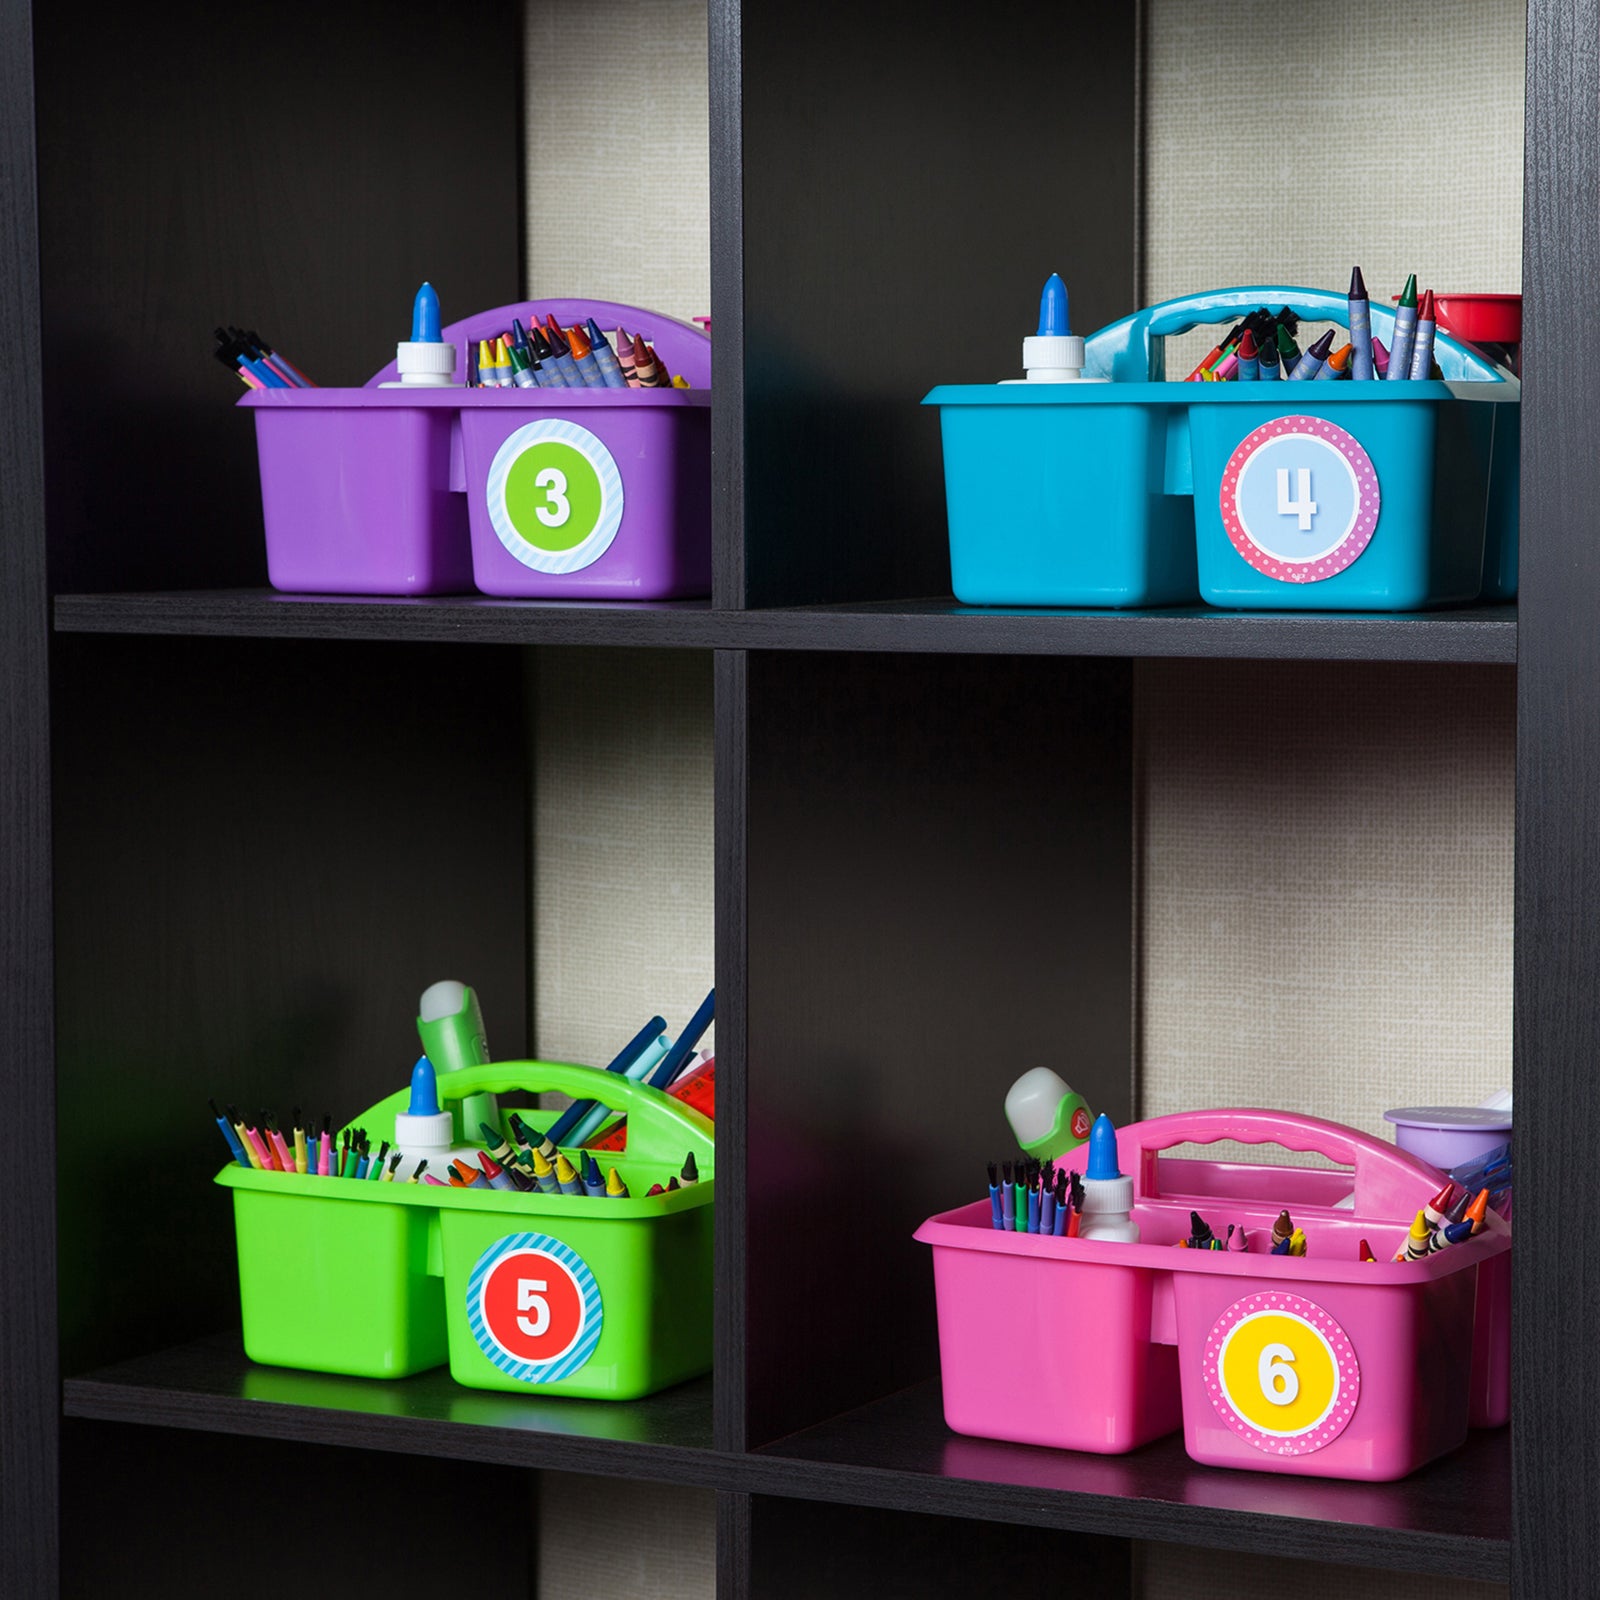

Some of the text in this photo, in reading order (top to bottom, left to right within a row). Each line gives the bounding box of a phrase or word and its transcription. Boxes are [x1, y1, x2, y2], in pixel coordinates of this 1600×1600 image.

[535, 468, 570, 527] 3
[1276, 468, 1317, 530] 4
[516, 1278, 551, 1337] 5
[1258, 1343, 1299, 1406] 6
